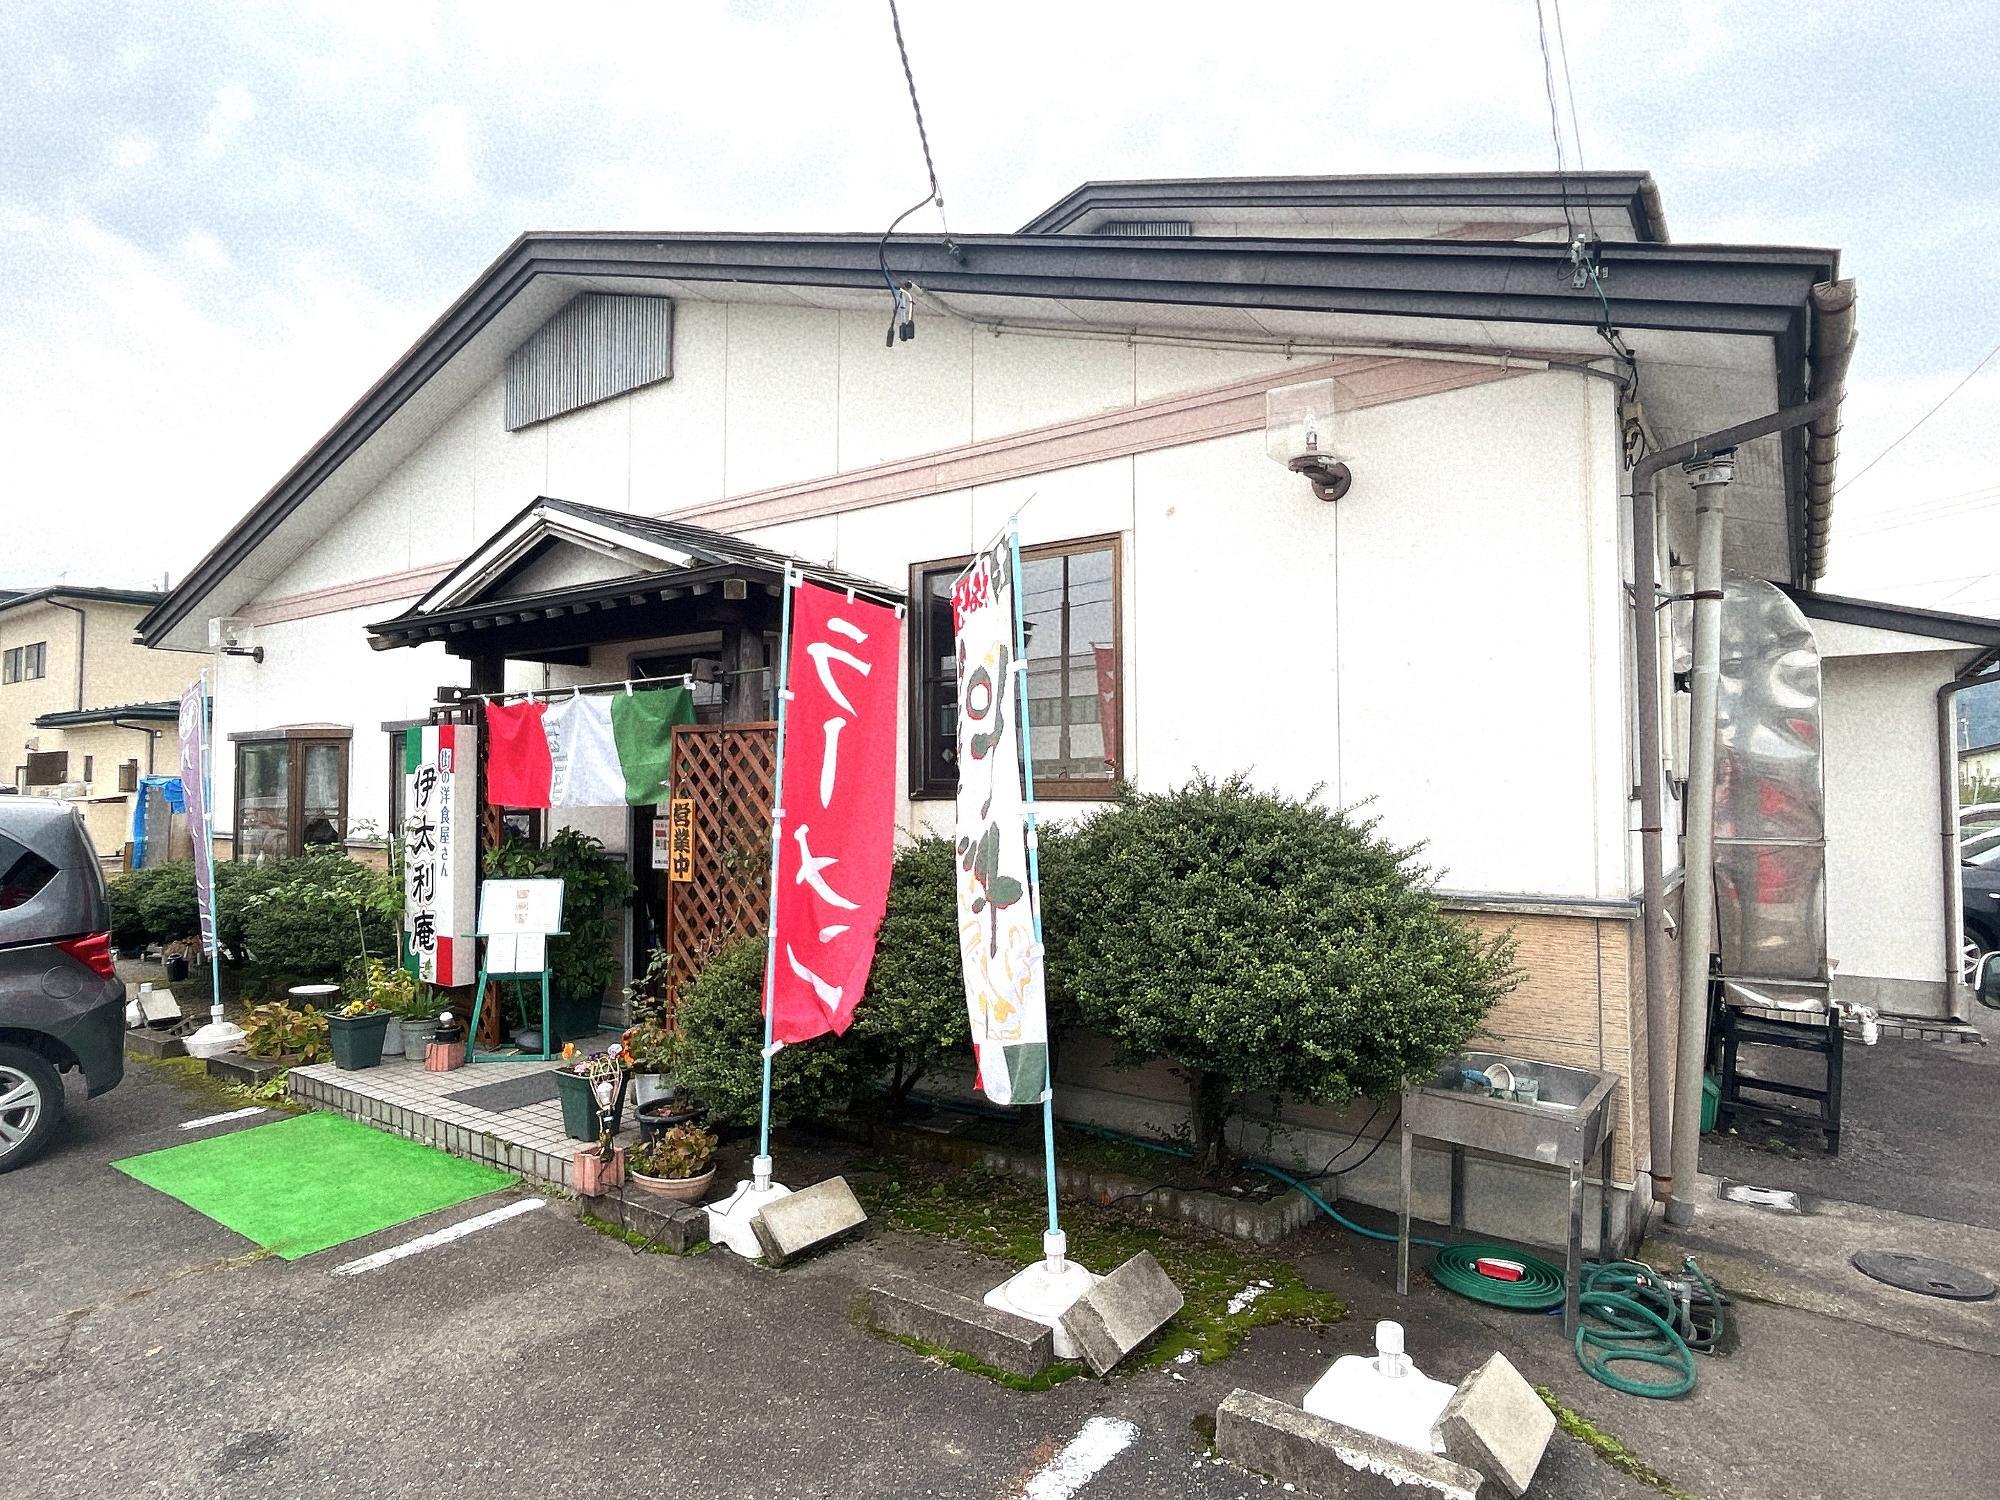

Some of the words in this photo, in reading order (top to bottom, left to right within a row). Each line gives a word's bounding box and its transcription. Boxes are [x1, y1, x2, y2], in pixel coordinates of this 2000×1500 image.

[411, 766, 437, 952] 伊太利庵
[440, 748, 452, 878] 街の洋食屋さん
[673, 802, 691, 879] 営業中
